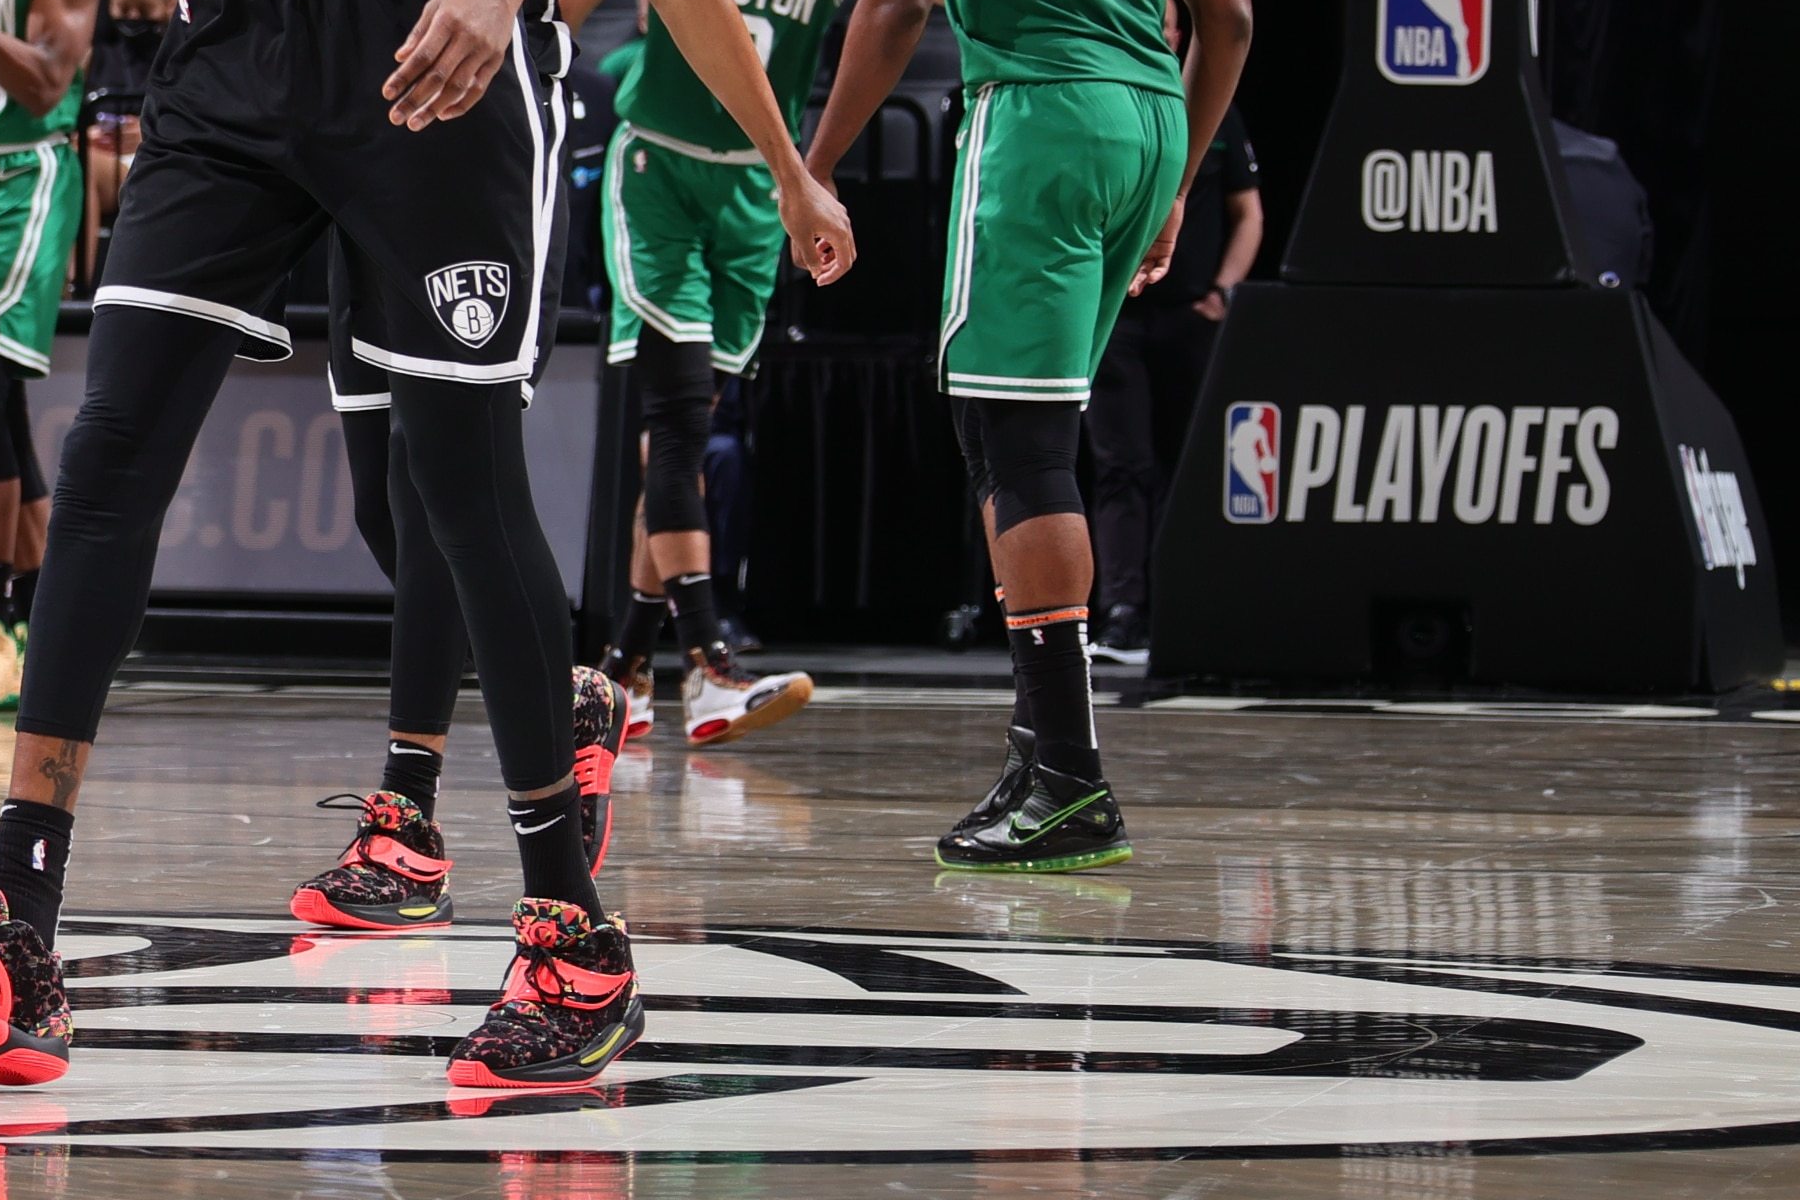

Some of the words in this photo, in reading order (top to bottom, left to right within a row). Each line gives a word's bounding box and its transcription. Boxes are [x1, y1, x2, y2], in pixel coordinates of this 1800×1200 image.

[1394, 26, 1447, 67] NBA
[1361, 149, 1498, 233] @NBA
[432, 265, 506, 307] NETS
[1285, 404, 1620, 526] PLAYOFFS
[1231, 495, 1260, 515] NBA
